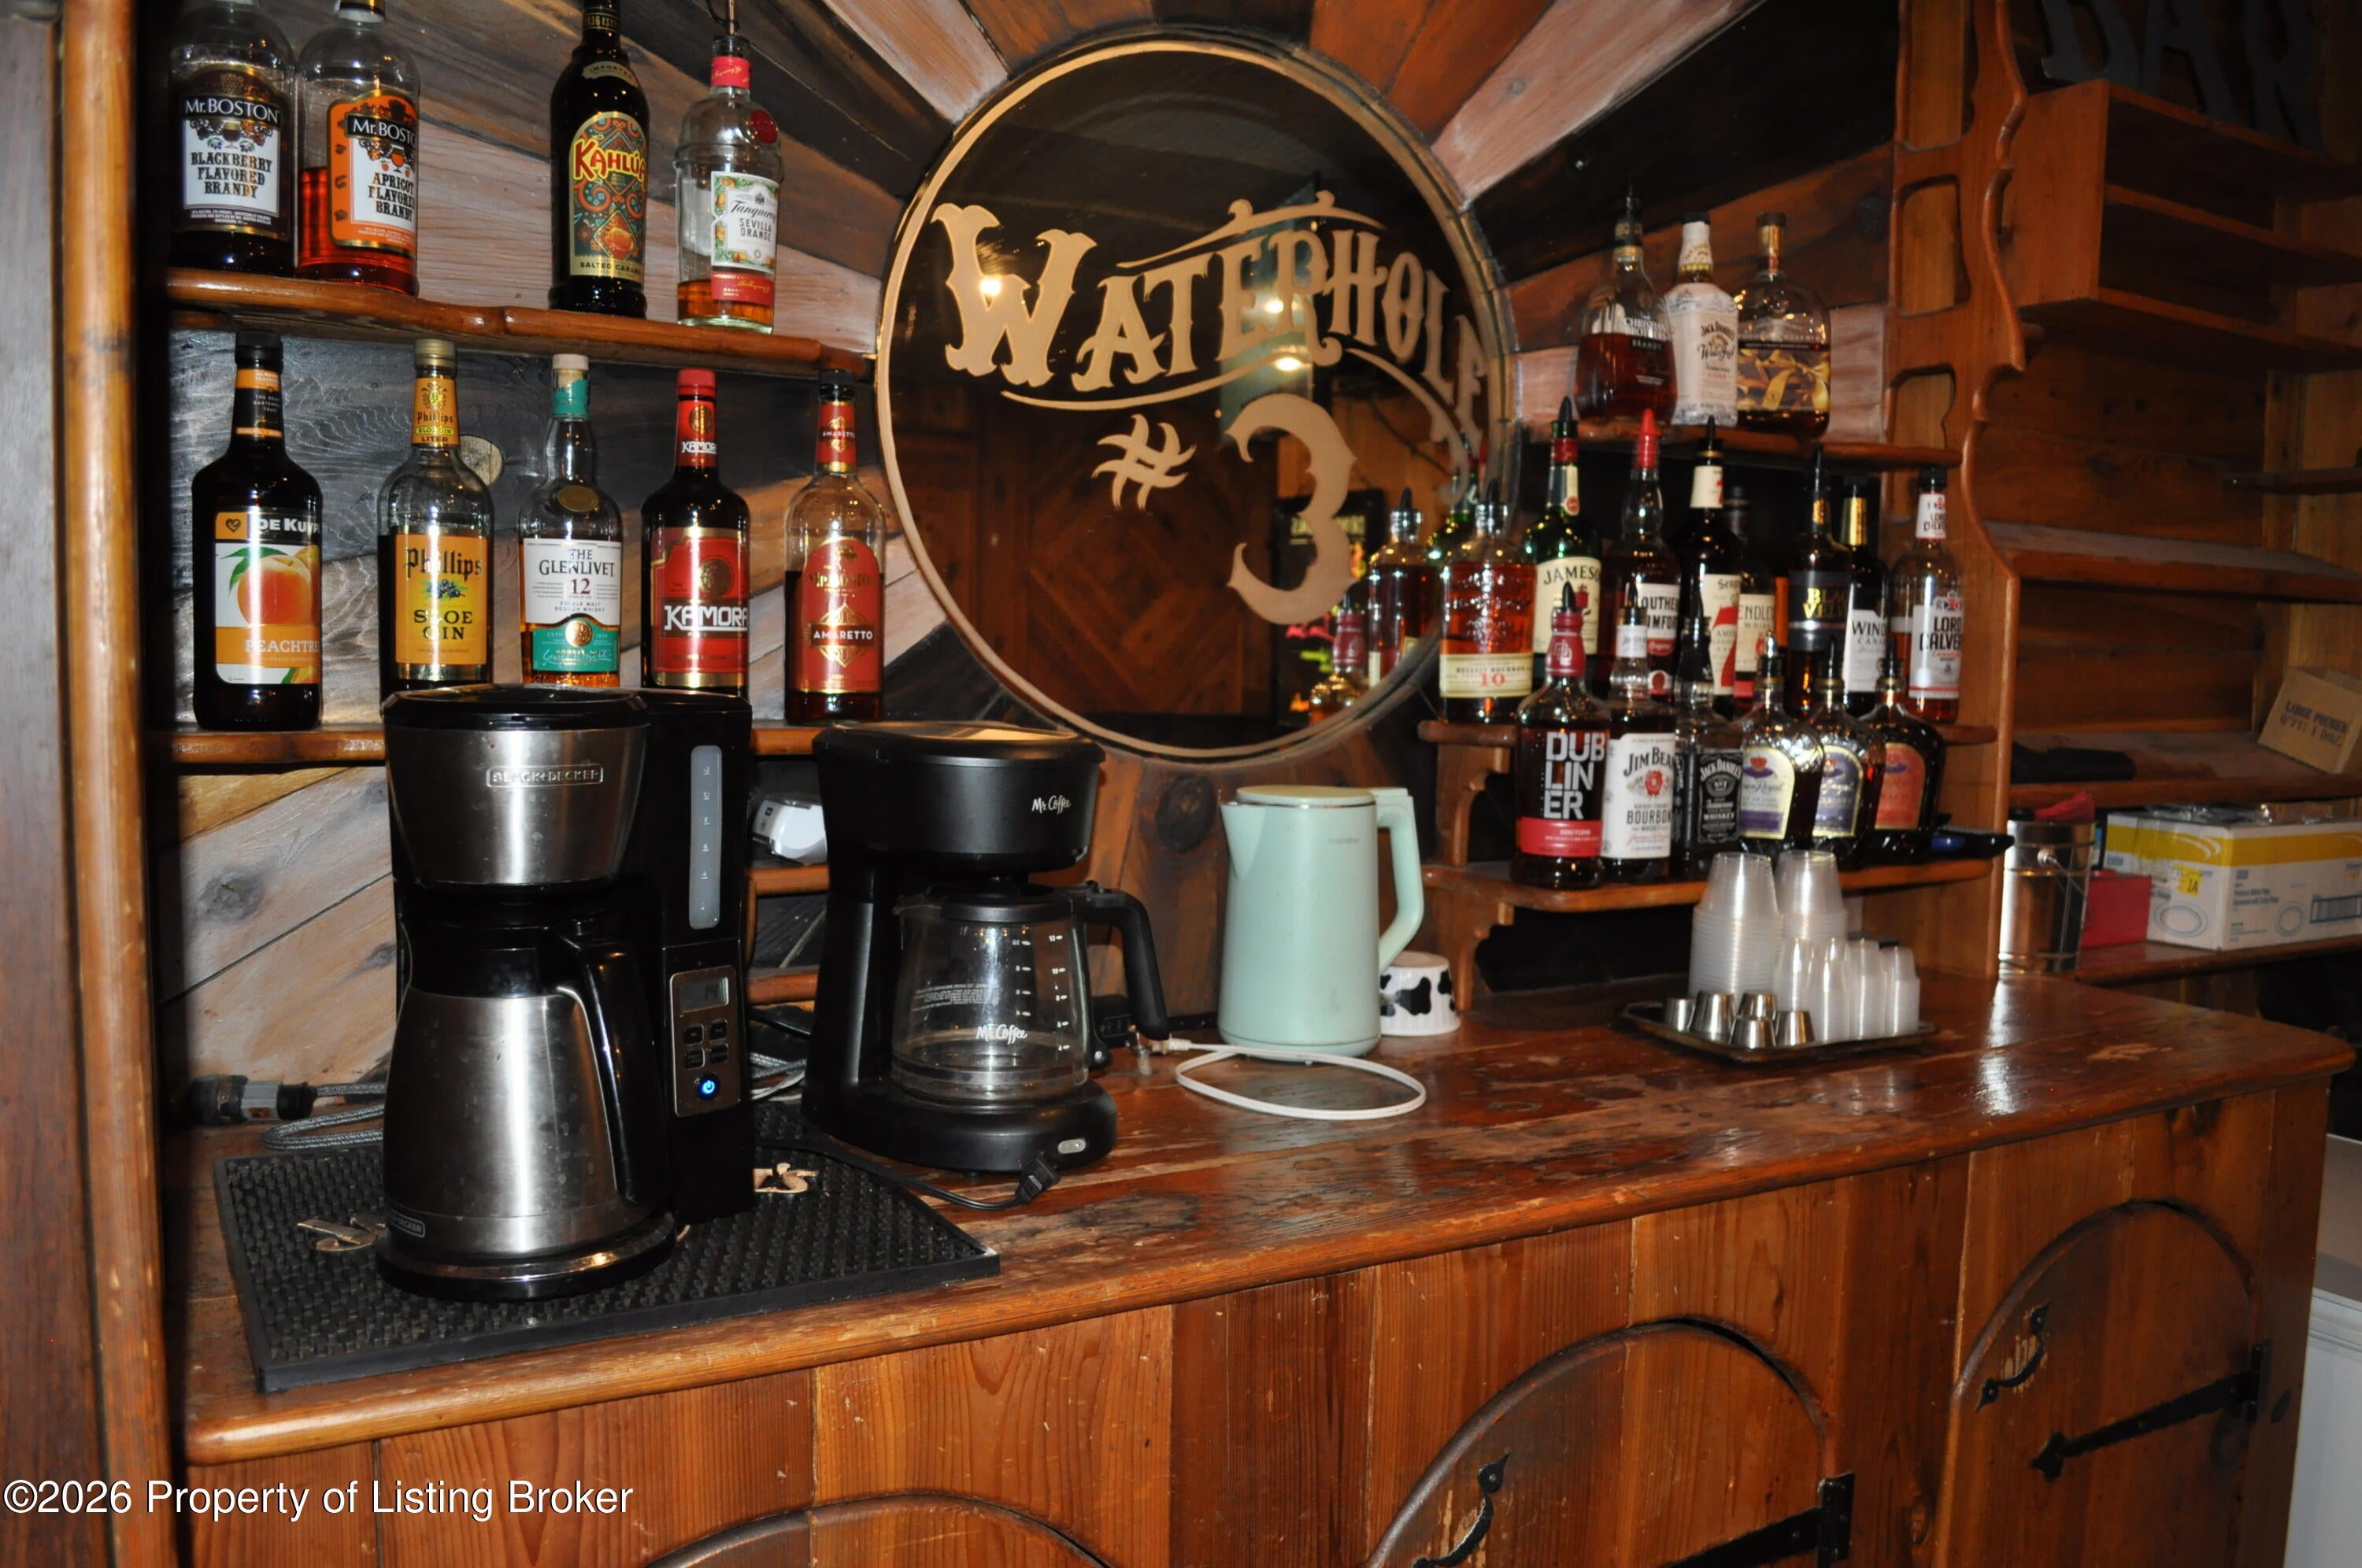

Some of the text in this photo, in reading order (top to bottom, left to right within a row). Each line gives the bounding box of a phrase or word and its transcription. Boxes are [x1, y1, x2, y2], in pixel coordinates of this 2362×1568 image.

[185, 98, 279, 124] Mr. BOSTON
[353, 118, 416, 145] Mr. BOSTO
[191, 151, 272, 173] BLACKBERRY
[573, 139, 646, 186] KAHLÚA
[198, 168, 265, 186] FLAVORED
[372, 172, 414, 194] APRICOT
[205, 182, 258, 198] BRANDY
[368, 187, 415, 206] FLAVORE
[739, 217, 772, 232] SEVILLA
[740, 227, 772, 242] ORANGE
[681, 441, 717, 455] KAMOR
[1092, 413, 1197, 512] #
[1226, 393, 1358, 625] 3
[283, 517, 320, 534] KUYP
[568, 548, 593, 560] THE
[539, 560, 616, 578] GLENLIVET
[1544, 564, 1601, 585] JAMESO
[570, 578, 591, 595] 12
[413, 609, 473, 624] SOE
[813, 631, 873, 640] AMARETTO
[1851, 620, 1888, 638] WIND
[245, 639, 319, 653] PEACHTRE
[1920, 632, 1961, 651] CALVE
[1479, 674, 1506, 687] 10
[1546, 731, 1605, 762] DUB
[1623, 753, 1649, 777] JIM
[1700, 761, 1716, 782] JACK
[492, 769, 599, 783] BLACK+DECKER
[1545, 761, 1594, 791] LIN
[1031, 794, 1072, 815] Mr. Coffee
[1543, 790, 1585, 820] ER
[1626, 809, 1672, 825] BOURBON
[995, 1024, 1028, 1045] Coffee
